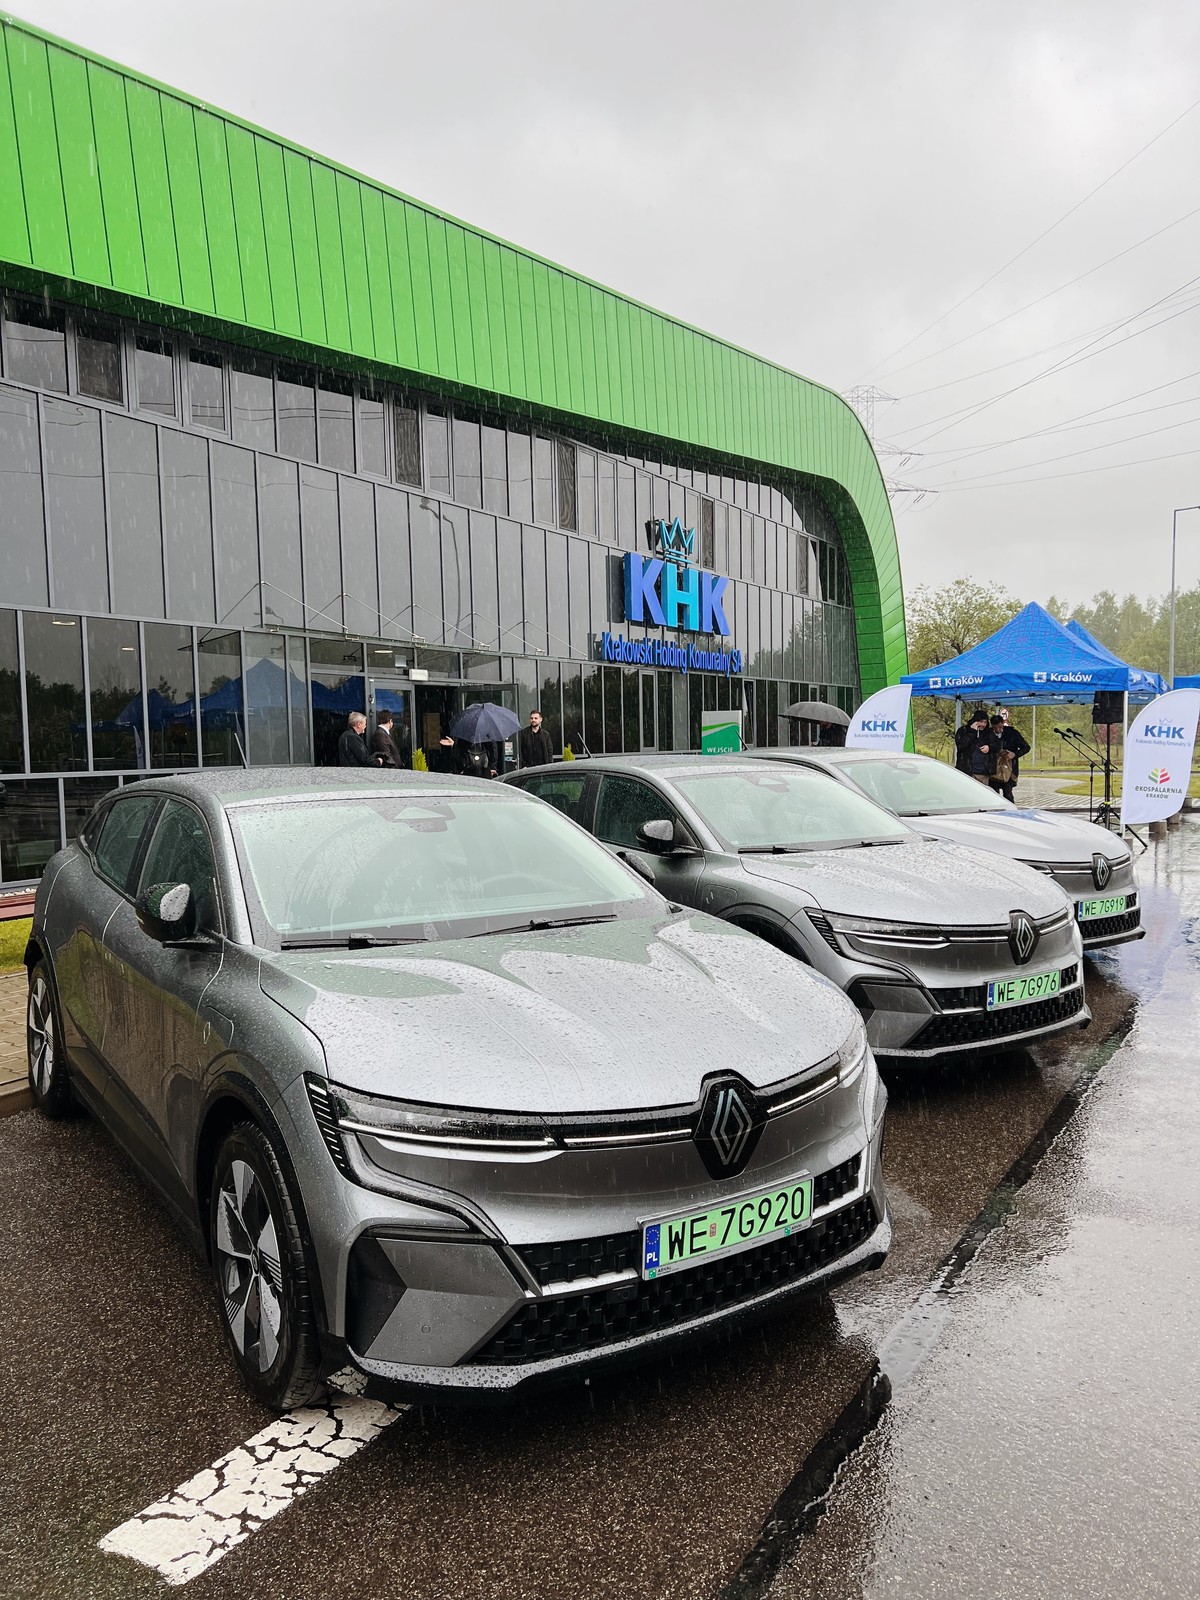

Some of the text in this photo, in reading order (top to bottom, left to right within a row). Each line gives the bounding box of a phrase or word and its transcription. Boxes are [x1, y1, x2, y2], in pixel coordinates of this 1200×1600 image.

[624, 552, 731, 636] KHK
[602, 631, 742, 677] Krakowski Holding Komunalny SA
[944, 675, 983, 687] Kraków
[1050, 672, 1092, 683] Kraków
[861, 720, 898, 732] KHK
[1144, 725, 1185, 740] KHK
[1085, 901, 1097, 916] WE
[1099, 897, 1124, 914] 7G919
[997, 972, 1057, 1002] WE 7G976
[667, 1186, 805, 1261] WE 7G920
[646, 1252, 658, 1264] PL
